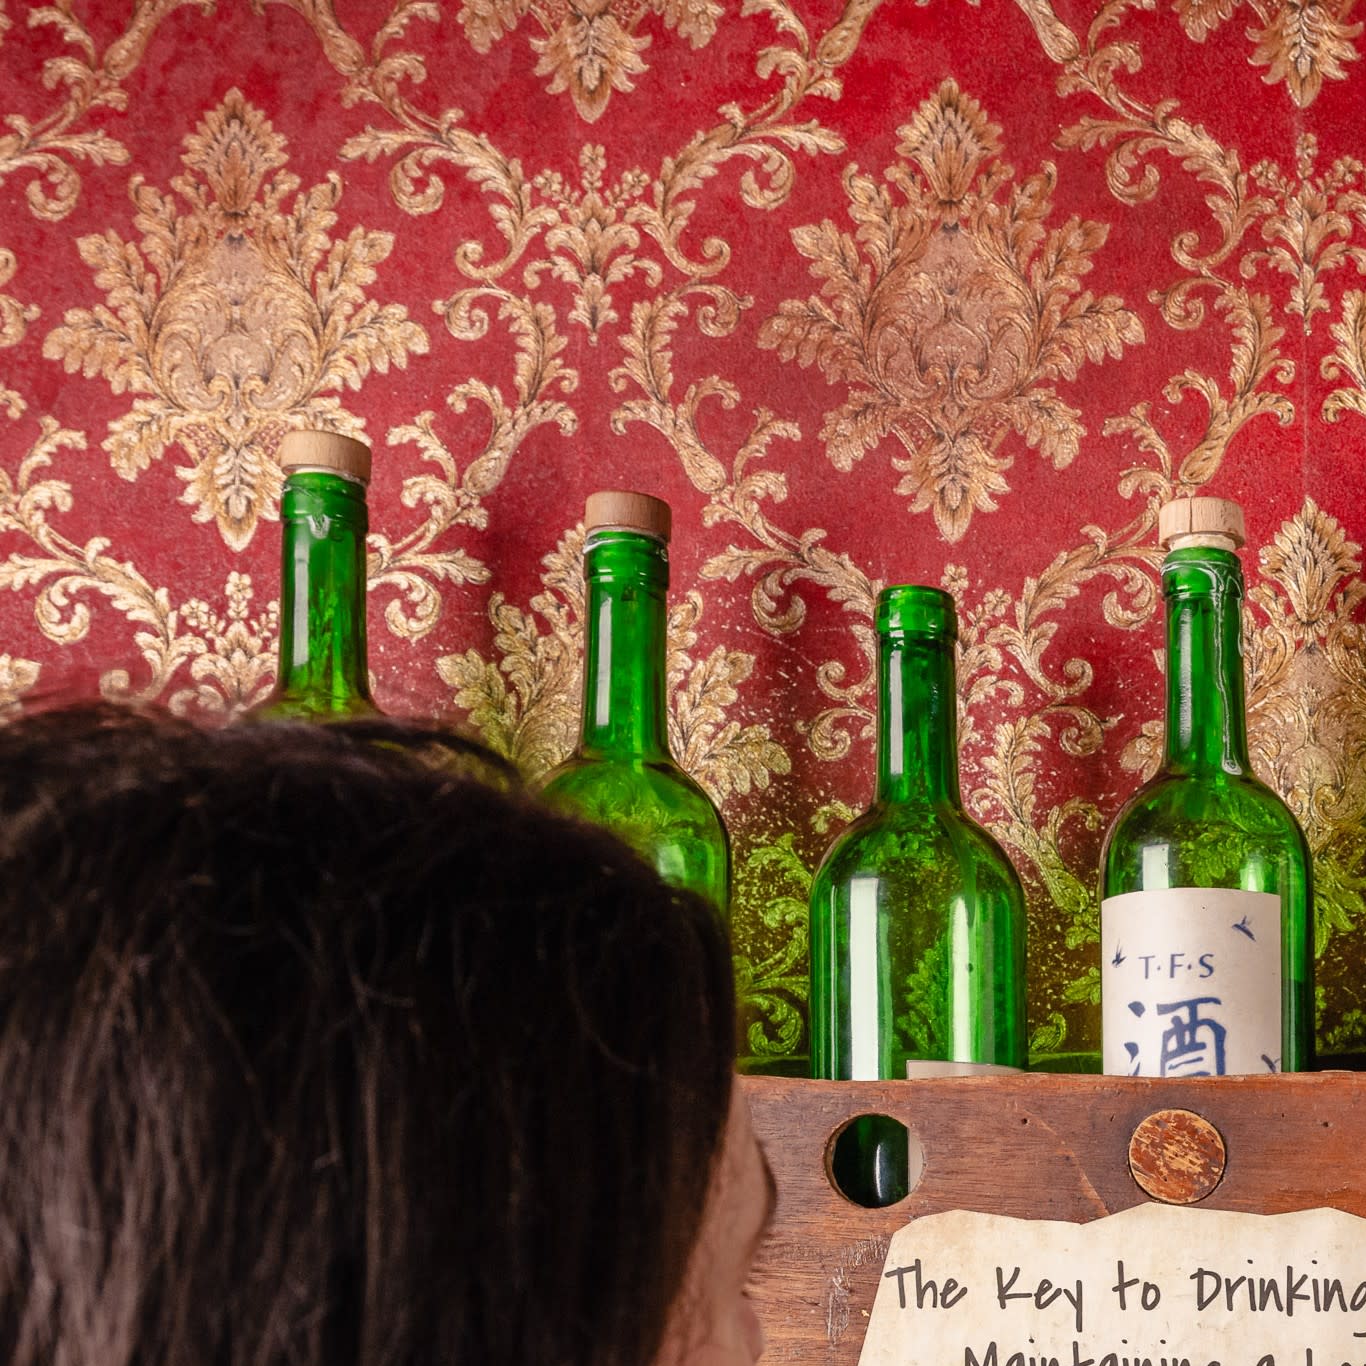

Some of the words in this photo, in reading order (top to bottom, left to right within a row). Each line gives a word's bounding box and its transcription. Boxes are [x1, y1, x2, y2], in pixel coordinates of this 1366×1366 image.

[1123, 996, 1227, 1076] 酒
[885, 1258, 968, 1310] The
[995, 1265, 1084, 1332] Key
[1113, 1259, 1162, 1313] to
